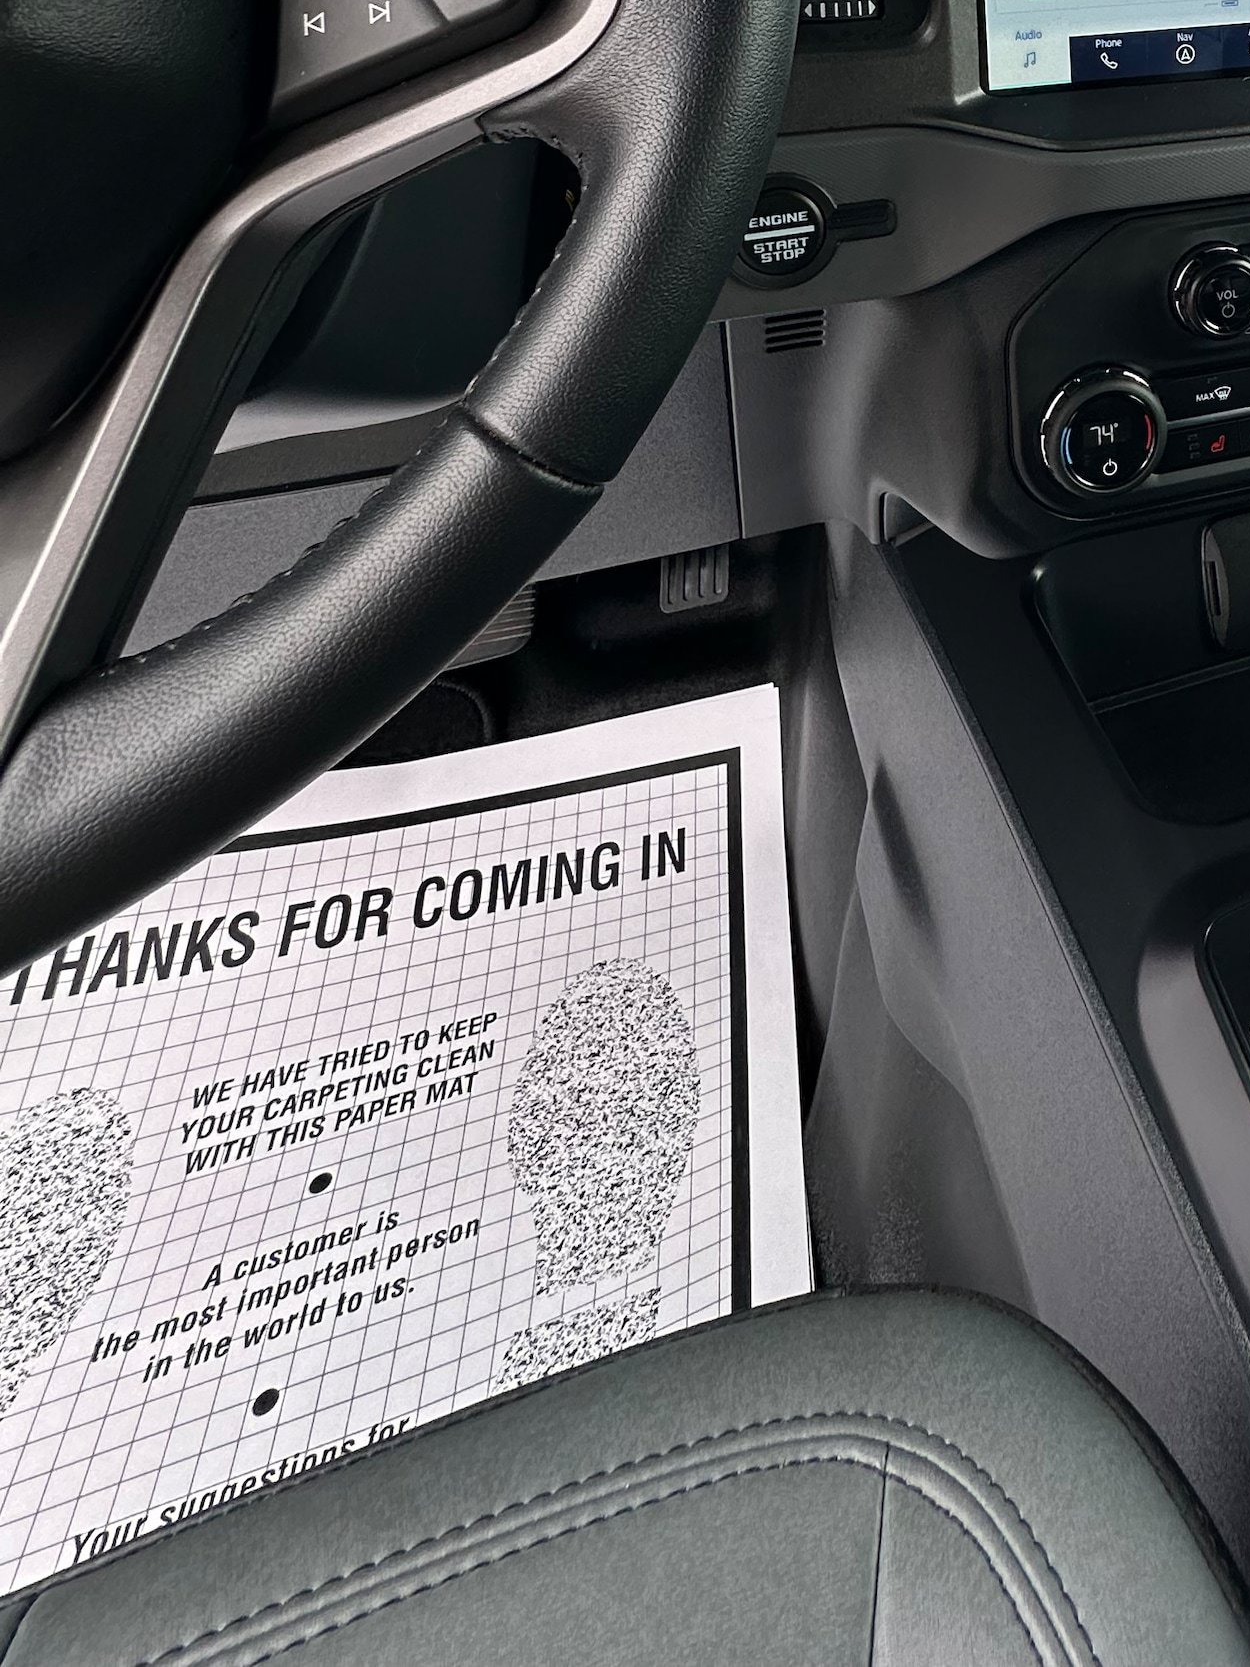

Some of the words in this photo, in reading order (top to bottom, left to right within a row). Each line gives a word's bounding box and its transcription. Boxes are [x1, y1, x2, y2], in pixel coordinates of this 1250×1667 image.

[1015, 29, 1042, 42] Audio
[1095, 38, 1123, 50] Phone
[1177, 32, 1193, 42] Nav
[748, 210, 809, 229] ENGINE
[753, 236, 809, 255] START
[761, 248, 806, 264] STOP
[1216, 289, 1239, 301] VOL
[1195, 392, 1215, 403] MAX
[278, 886, 393, 959] FOR
[412, 839, 621, 931] COMING
[640, 827, 687, 883] IN
[192, 1078, 235, 1110] WE
[240, 1059, 310, 1097] HAVE
[319, 1039, 390, 1076] TRIED
[400, 1029, 430, 1054] TO
[438, 1011, 497, 1045] KEEP
[182, 1105, 255, 1144] YOUR
[263, 1063, 409, 1122] CARPETING
[417, 1039, 495, 1078] CLEAN
[185, 1134, 257, 1175] WITH
[266, 1116, 326, 1152] THIS
[334, 1089, 417, 1132] PAPER
[425, 1071, 479, 1106] MAT
[201, 1263, 222, 1291] A
[233, 1221, 367, 1280] customer
[375, 1209, 401, 1233] is
[91, 1329, 141, 1363] the
[150, 1295, 229, 1344] most
[236, 1247, 379, 1316] important
[386, 1216, 481, 1271] person
[142, 1354, 173, 1383] in
[184, 1334, 233, 1370] the
[243, 1299, 327, 1350] world
[336, 1288, 364, 1318] to
[374, 1274, 416, 1305] us.
[72, 1514, 149, 1566] Your
[368, 1416, 412, 1447] for
